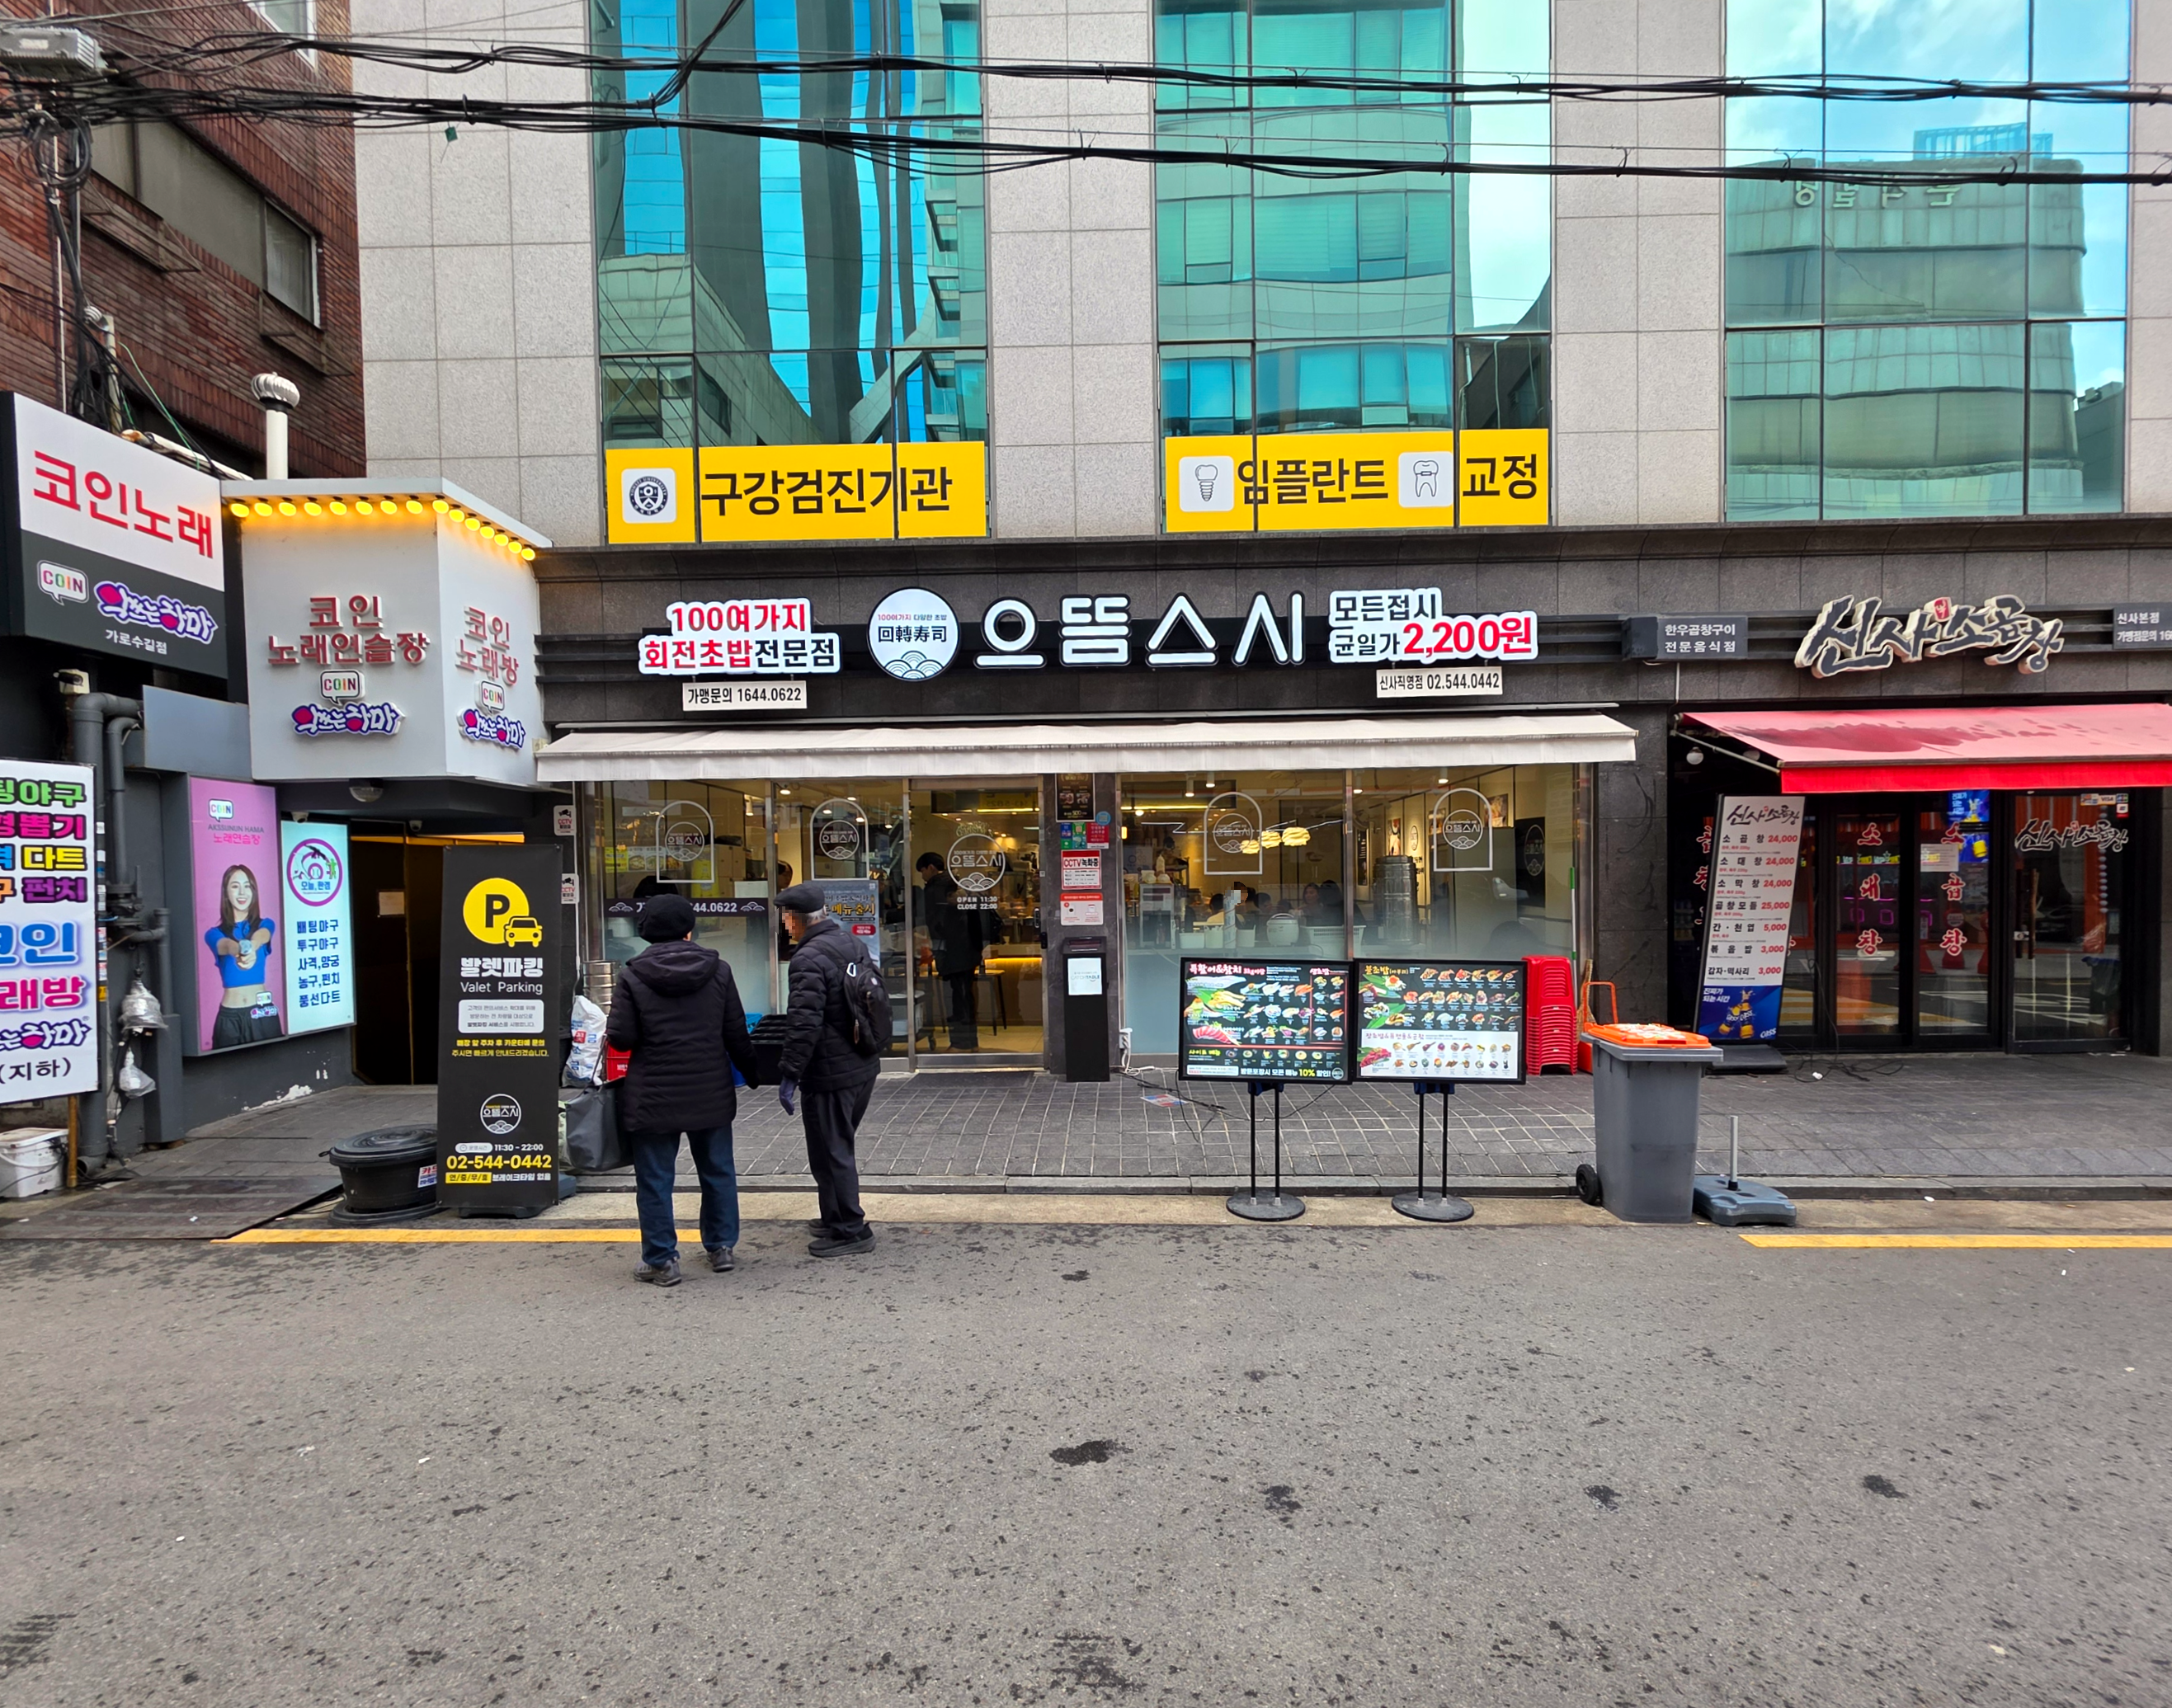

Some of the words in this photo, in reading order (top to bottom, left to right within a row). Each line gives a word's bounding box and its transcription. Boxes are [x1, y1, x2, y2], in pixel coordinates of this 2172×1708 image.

[1237, 459, 1388, 505] 임플란트
[1463, 454, 1537, 499] 교정
[701, 467, 952, 516] 구강검진기관
[32, 450, 213, 558] 코인노래
[41, 567, 86, 595] COIN
[309, 595, 384, 628] 코인
[1335, 594, 1435, 621] 모든접시
[671, 604, 805, 633] 100여가지
[2117, 612, 2160, 624] 신사본점
[464, 605, 511, 649] 코인
[976, 593, 1303, 666] 으뜸스시
[1665, 623, 1736, 637] 한우곱창구이
[2159, 630, 2172, 641] 16
[105, 628, 167, 655] 가로수길점
[1335, 633, 1400, 656] 균일가
[1404, 617, 1531, 657] 2,200원
[267, 632, 430, 666] 노래연습장
[644, 639, 835, 669] 회전초밥전문점
[1665, 640, 1736, 653] 전문음식점
[455, 638, 519, 686] 노래방
[322, 675, 360, 694] COIN
[1379, 675, 1423, 690] 신사직영점
[1427, 673, 1500, 689] 02.544.0442
[481, 686, 504, 708] COIN
[688, 688, 733, 705] 가맹문의
[737, 688, 802, 703] 1644.0622
[210, 803, 232, 814] COIN
[213, 833, 261, 845] 노래연습장
[1768, 835, 1797, 844] 24,000
[21, 845, 87, 870] 다트
[1765, 857, 1795, 866] 24,000
[22, 877, 87, 903] 펀치
[1763, 879, 1793, 888] 24,000
[485, 894, 510, 928] P
[1761, 901, 1790, 910] 25,000
[297, 920, 338, 934] 배팅야구
[1764, 924, 1787, 932] 5,000
[0, 921, 78, 965] 인
[297, 937, 338, 953] 투구야구
[1760, 945, 1784, 954] 3,000
[298, 955, 340, 971] 사격,양궁
[460, 958, 543, 977] 발렛파킹
[1758, 967, 1781, 976] 3,000
[299, 972, 340, 989] 농구,펀치
[460, 982, 491, 992] Valet
[498, 982, 543, 995] Parking
[299, 990, 340, 1007] 풍선다트
[1299, 1069, 1315, 1077] 10%
[446, 1155, 552, 1169] 02-544-0442
